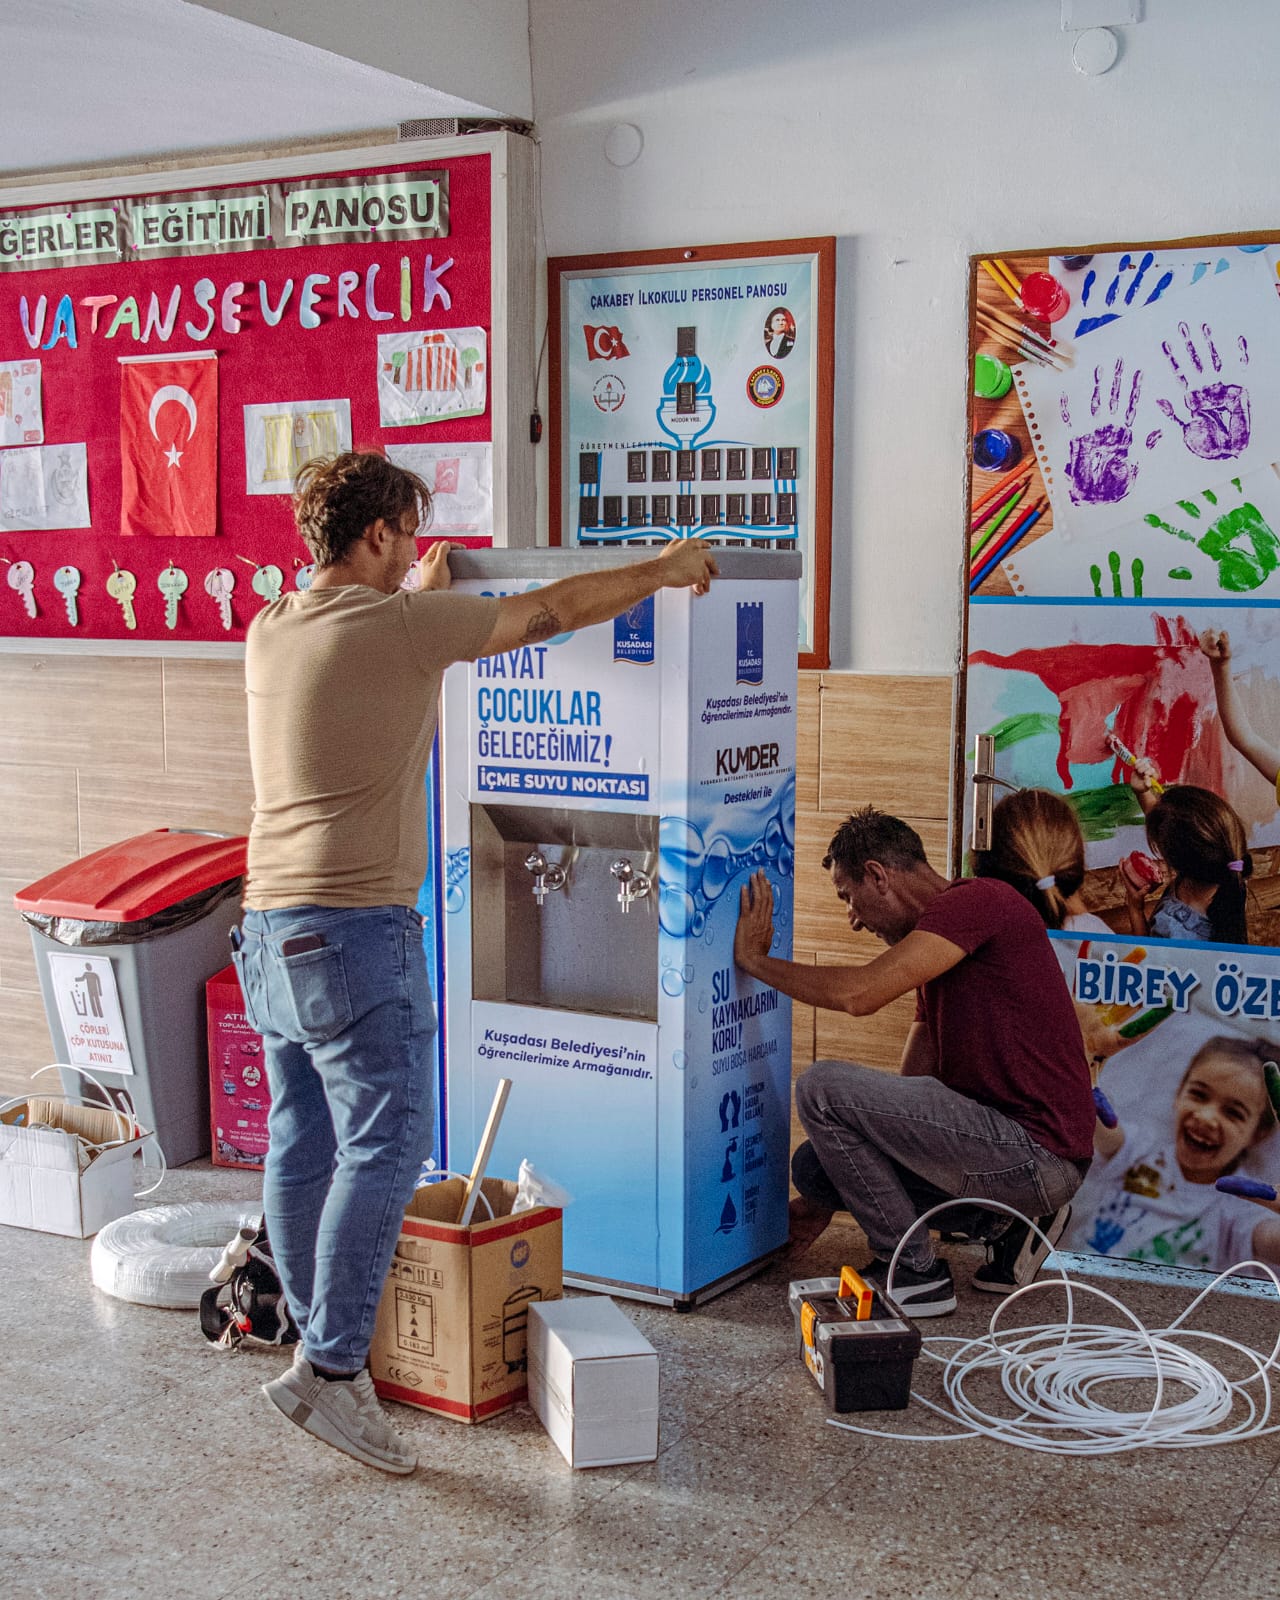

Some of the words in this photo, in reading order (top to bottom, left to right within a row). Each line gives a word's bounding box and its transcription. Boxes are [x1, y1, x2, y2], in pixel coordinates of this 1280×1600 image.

[0, 220, 116, 256] ĞERLER
[143, 201, 265, 245] EĞİTİMİ
[291, 192, 435, 231] PANOSU
[590, 293, 635, 310] ÇAKABEY
[638, 289, 688, 305] İLKOKULU
[692, 286, 744, 302] PERSONEL
[746, 282, 788, 298] PANOSU
[477, 647, 548, 680] HAYAT
[477, 687, 601, 728] ÇOCUKLAR
[706, 695, 742, 711] Kuşadası
[716, 742, 780, 776] KUMDER
[480, 766, 521, 790] İÇME
[524, 774, 568, 791] SUYU
[572, 776, 646, 796] NOKTASI
[723, 787, 763, 805] Destekleri
[763, 786, 772, 797] ile
[712, 967, 730, 1005] SU
[1078, 952, 1198, 1010] BİREY
[224, 1013, 247, 1021] ATI
[712, 989, 778, 1030] KAYNAKLARINI
[86, 1038, 126, 1052] KUTUSUNA
[484, 1029, 547, 1048] Kuşadası
[89, 1052, 113, 1064] ATINIZ
[477, 1043, 570, 1068] Öğrencilerimize
[572, 1059, 653, 1080] Armağanıdır.
[712, 1056, 730, 1076] SUYU
[410, 1304, 417, 1314] 5
